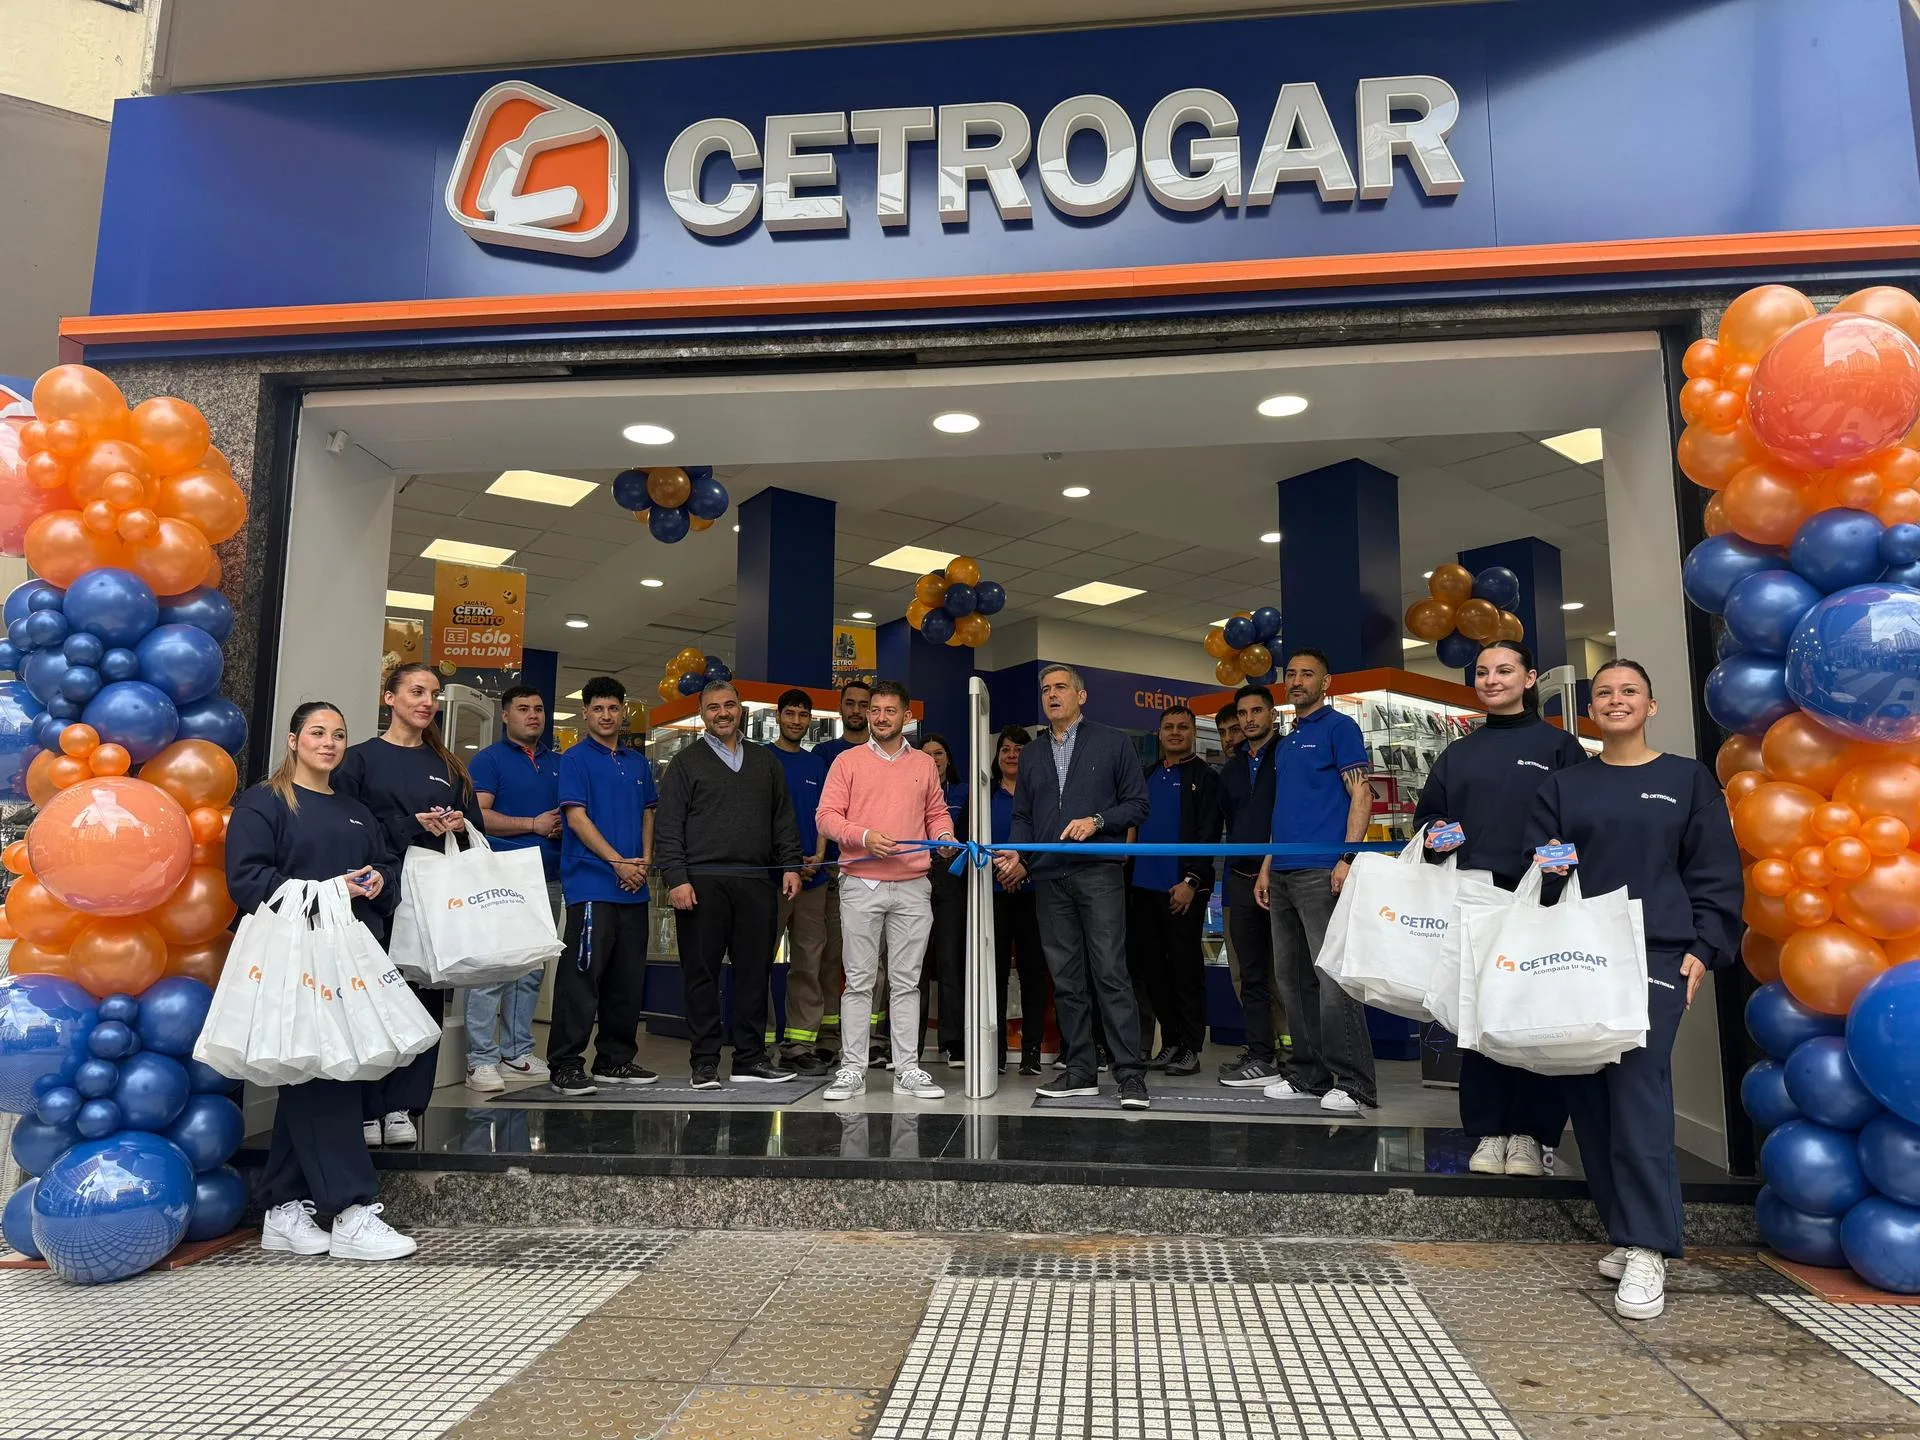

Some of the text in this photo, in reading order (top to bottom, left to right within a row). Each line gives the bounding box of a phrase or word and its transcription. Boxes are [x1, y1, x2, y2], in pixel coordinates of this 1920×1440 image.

[663, 75, 1465, 237] CETROGAR
[455, 606, 494, 616] CETRO
[470, 628, 511, 645] sólo
[443, 646, 512, 657] con tu DNI
[1134, 688, 1190, 711] CRÉDIT
[1519, 950, 1608, 972] CETROGAR
[1533, 964, 1570, 976] Acompaña
[1580, 964, 1595, 972] vida
